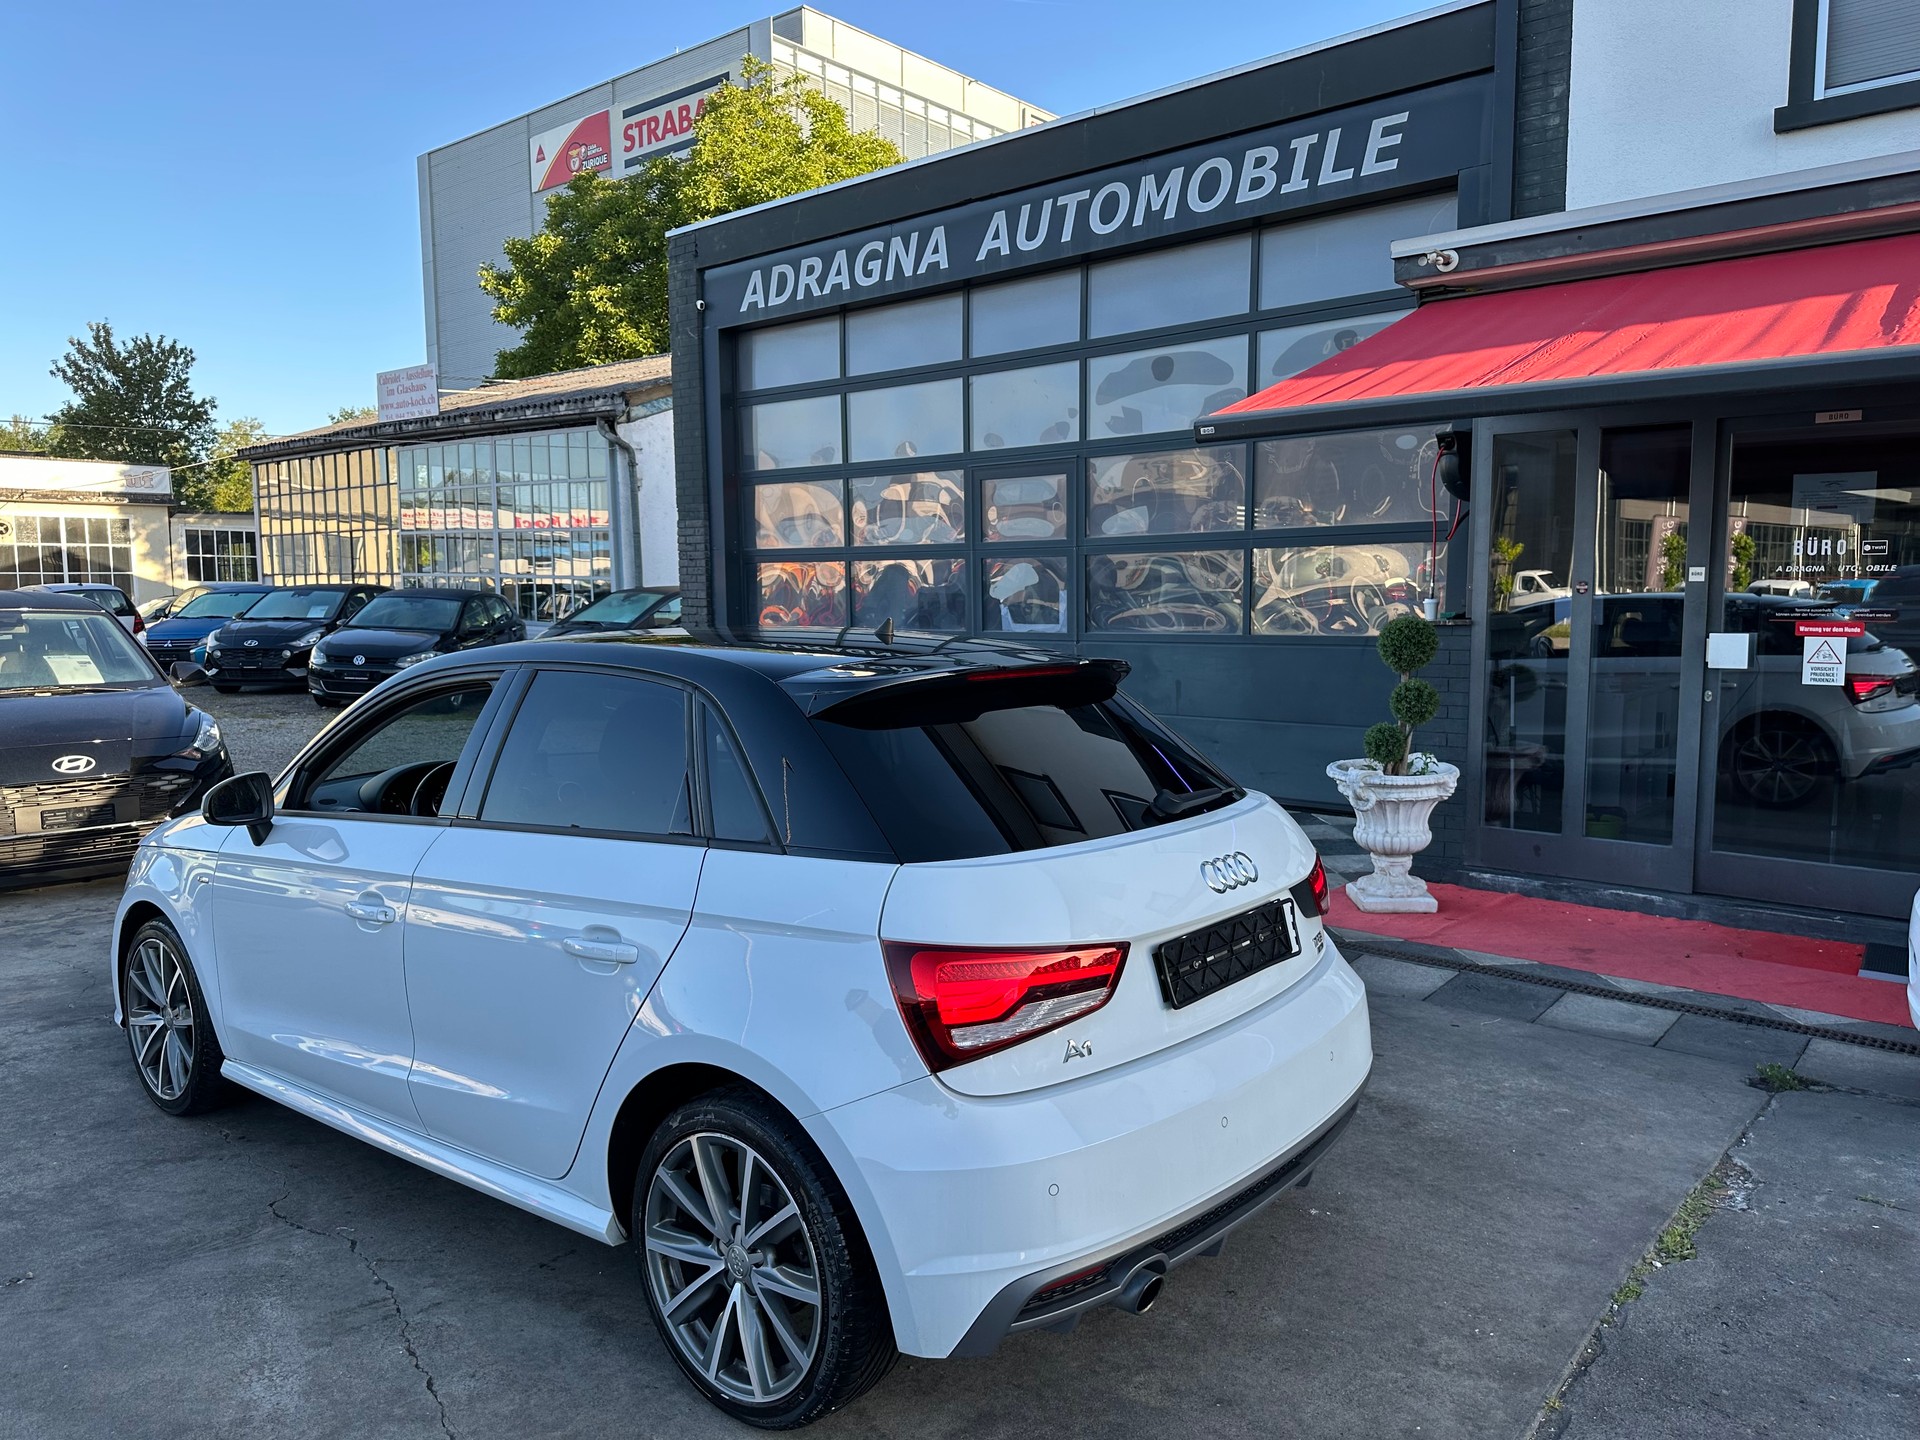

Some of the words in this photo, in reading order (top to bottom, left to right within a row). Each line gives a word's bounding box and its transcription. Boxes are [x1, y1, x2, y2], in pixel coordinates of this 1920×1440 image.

[623, 98, 706, 153] STRABA
[582, 154, 608, 170] ZURIQUE
[740, 225, 949, 313] ADRAGNA
[976, 111, 1410, 261] AUTOMOBILE
[387, 386, 395, 396] im
[397, 382, 427, 395] Glashaus
[380, 394, 436, 410] www.auto-koch.ch
[1793, 537, 1847, 556] BÜRO
[1063, 1039, 1092, 1063] A1
